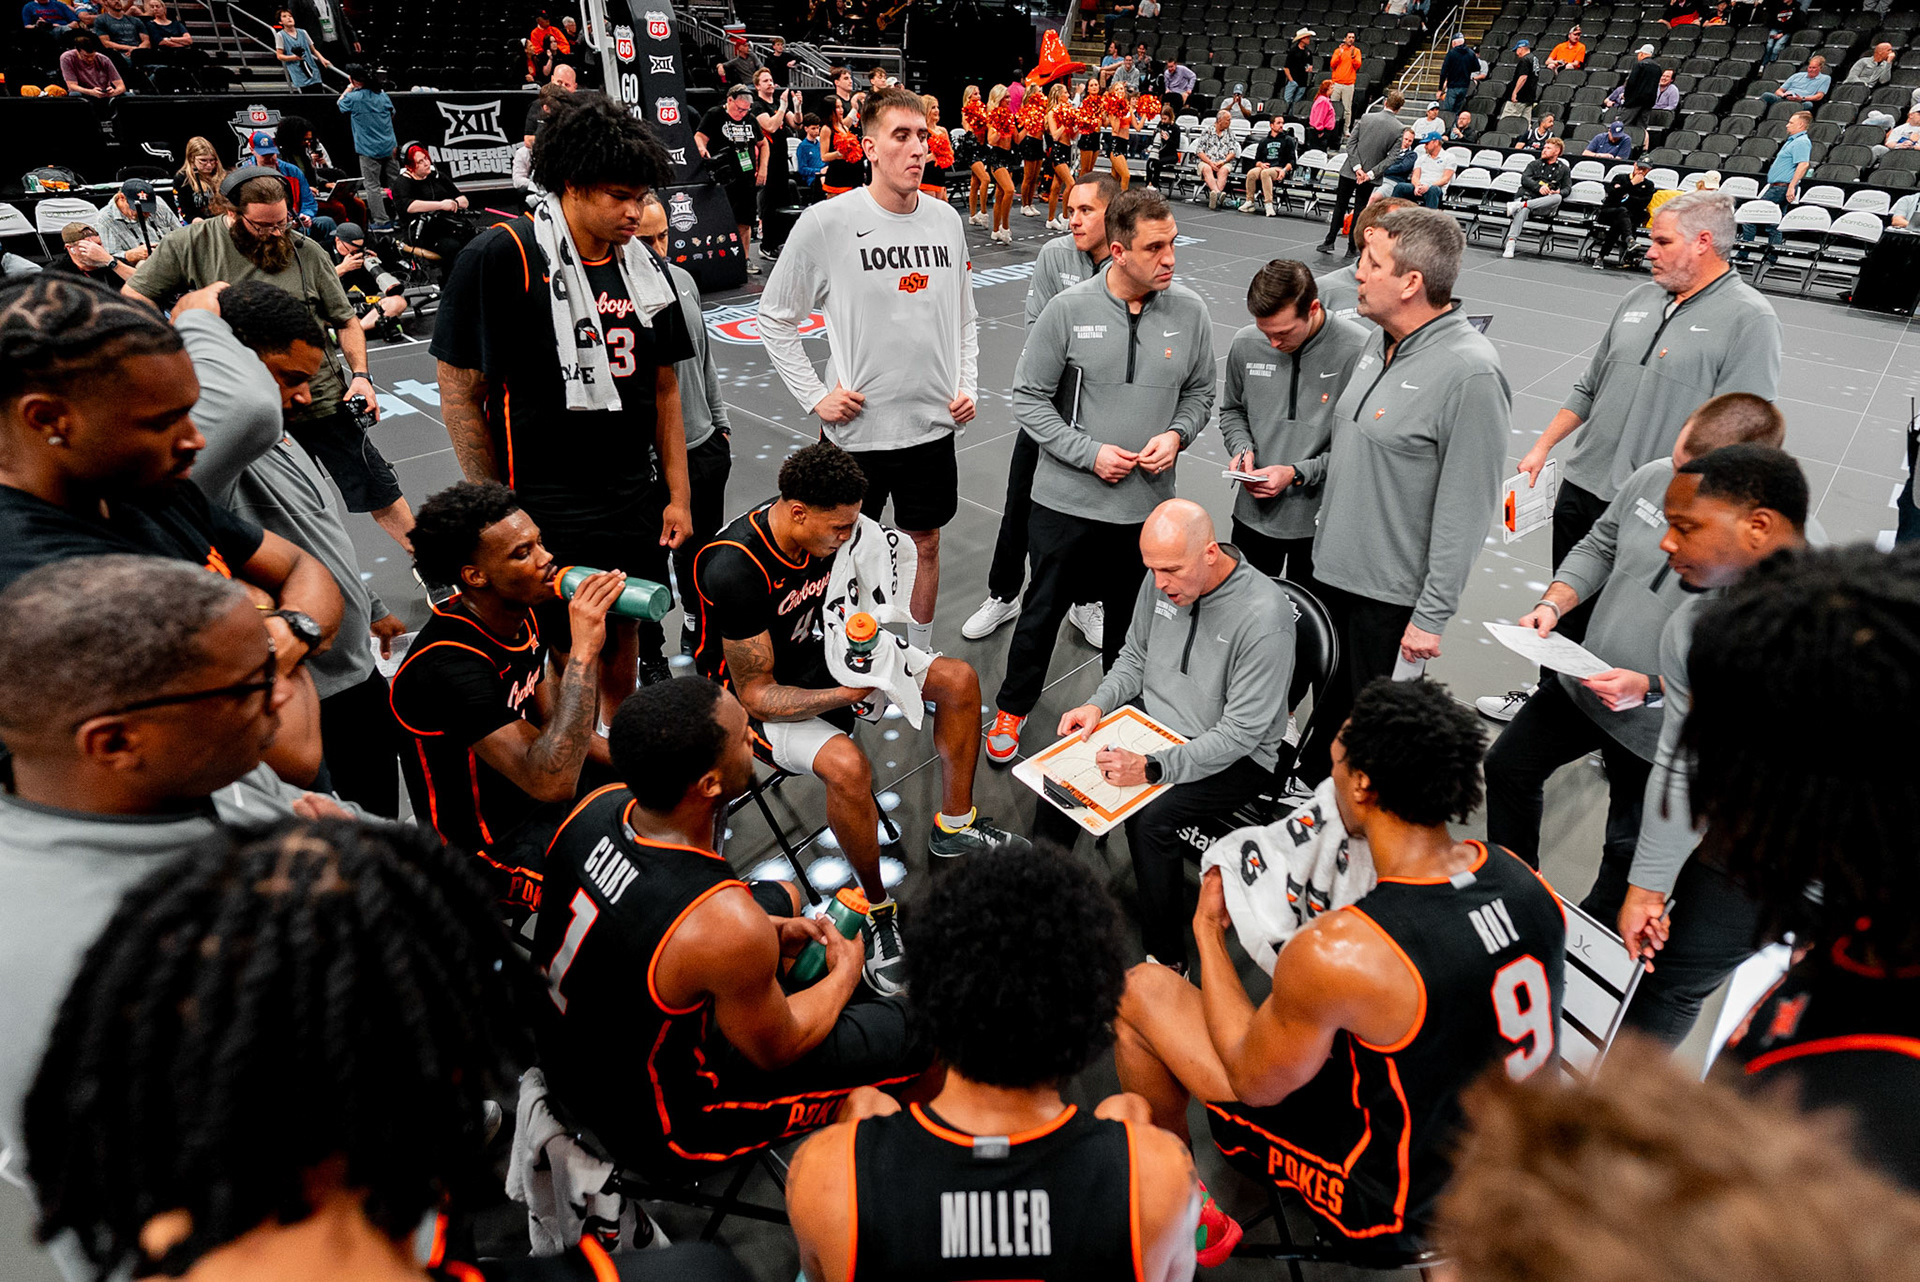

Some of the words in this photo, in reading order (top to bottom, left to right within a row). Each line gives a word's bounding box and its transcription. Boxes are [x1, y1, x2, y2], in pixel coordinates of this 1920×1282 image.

[651, 23, 665, 34] 66
[619, 41, 631, 55] 66
[621, 73, 638, 104] GO
[253, 112, 265, 120] 66
[661, 109, 676, 120] 66
[428, 145, 441, 163] A
[440, 142, 525, 162] DIFFEREN
[449, 158, 512, 178] LEAGUE
[860, 246, 903, 271] LOCK
[914, 245, 930, 267] IT
[898, 272, 929, 293] OSU
[584, 835, 640, 905] CLARY
[1468, 898, 1520, 955] ROY
[540, 886, 600, 1015] 1
[1490, 953, 1554, 1083] 9
[1268, 1145, 1345, 1216] POKES
[940, 1189, 1052, 1259] MILLER
